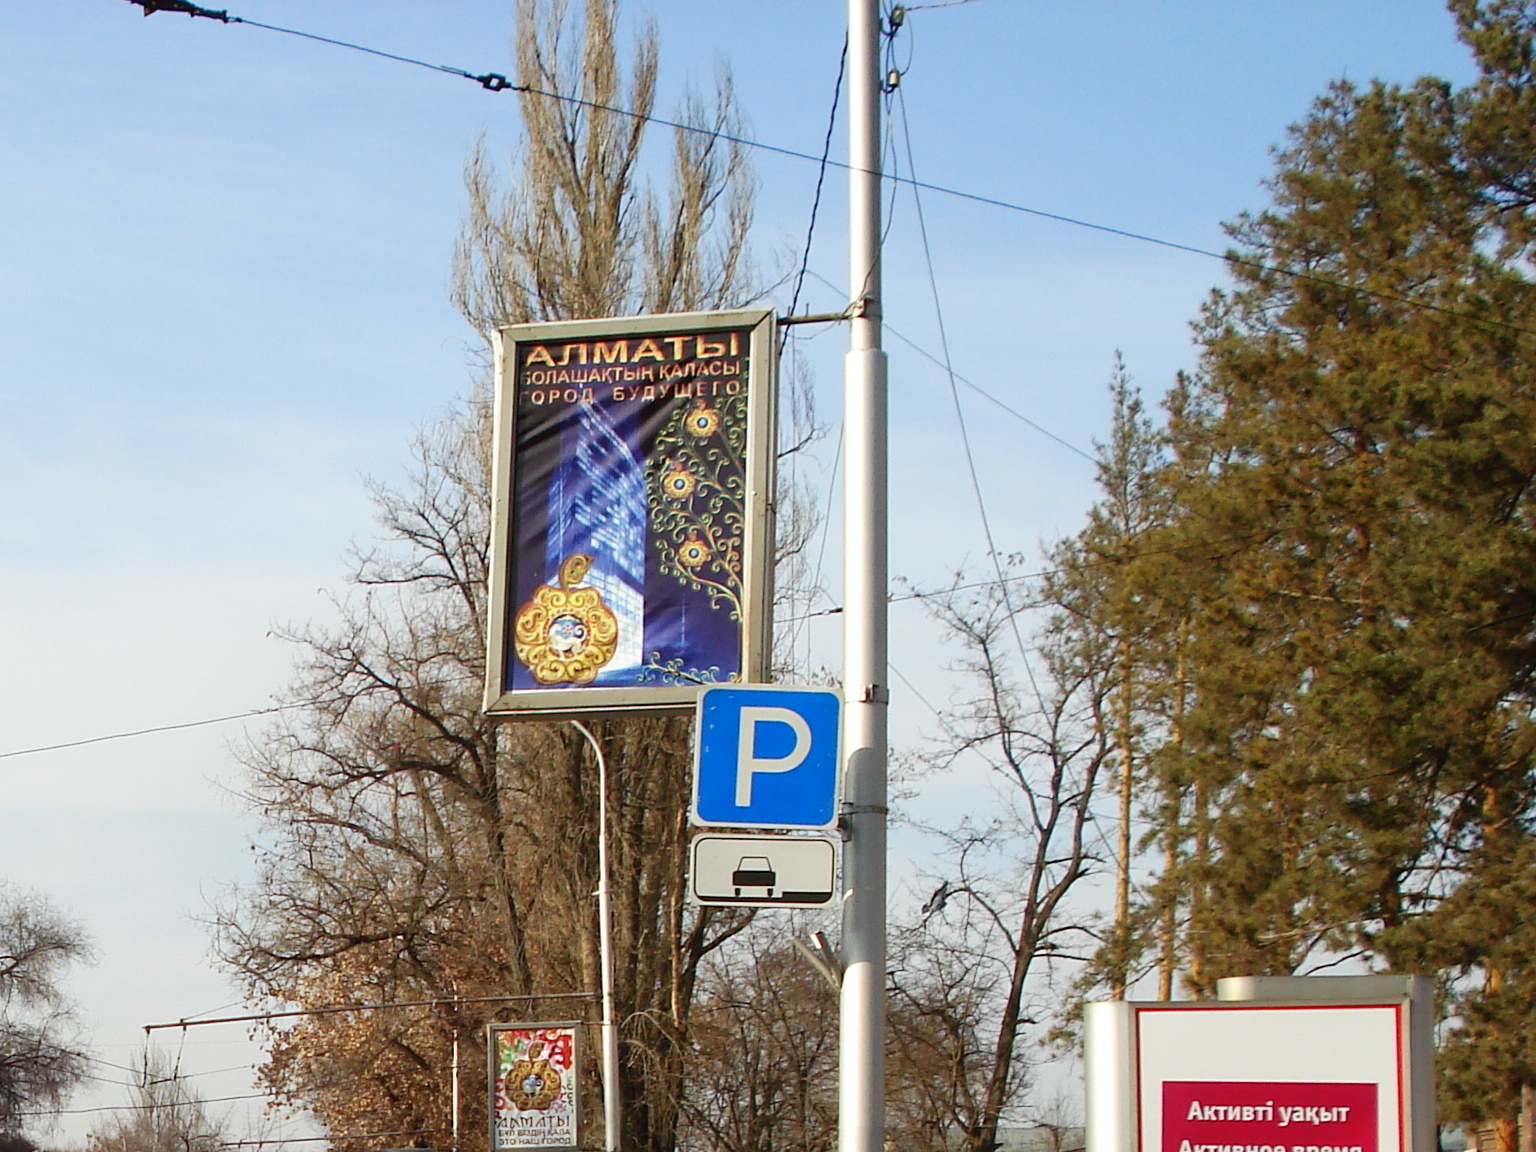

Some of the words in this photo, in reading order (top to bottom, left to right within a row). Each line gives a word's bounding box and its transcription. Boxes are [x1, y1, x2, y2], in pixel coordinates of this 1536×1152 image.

[525, 332, 740, 367] АЛМАТЫ
[659, 360, 740, 382] ҚАЛАСЫ
[613, 380, 740, 402] БУДУЩЕГО
[735, 706, 812, 807] P
[497, 1115, 570, 1131] АЛМАТЫ
[1187, 1100, 1274, 1122] Активті
[1278, 1105, 1350, 1127] уақыт
